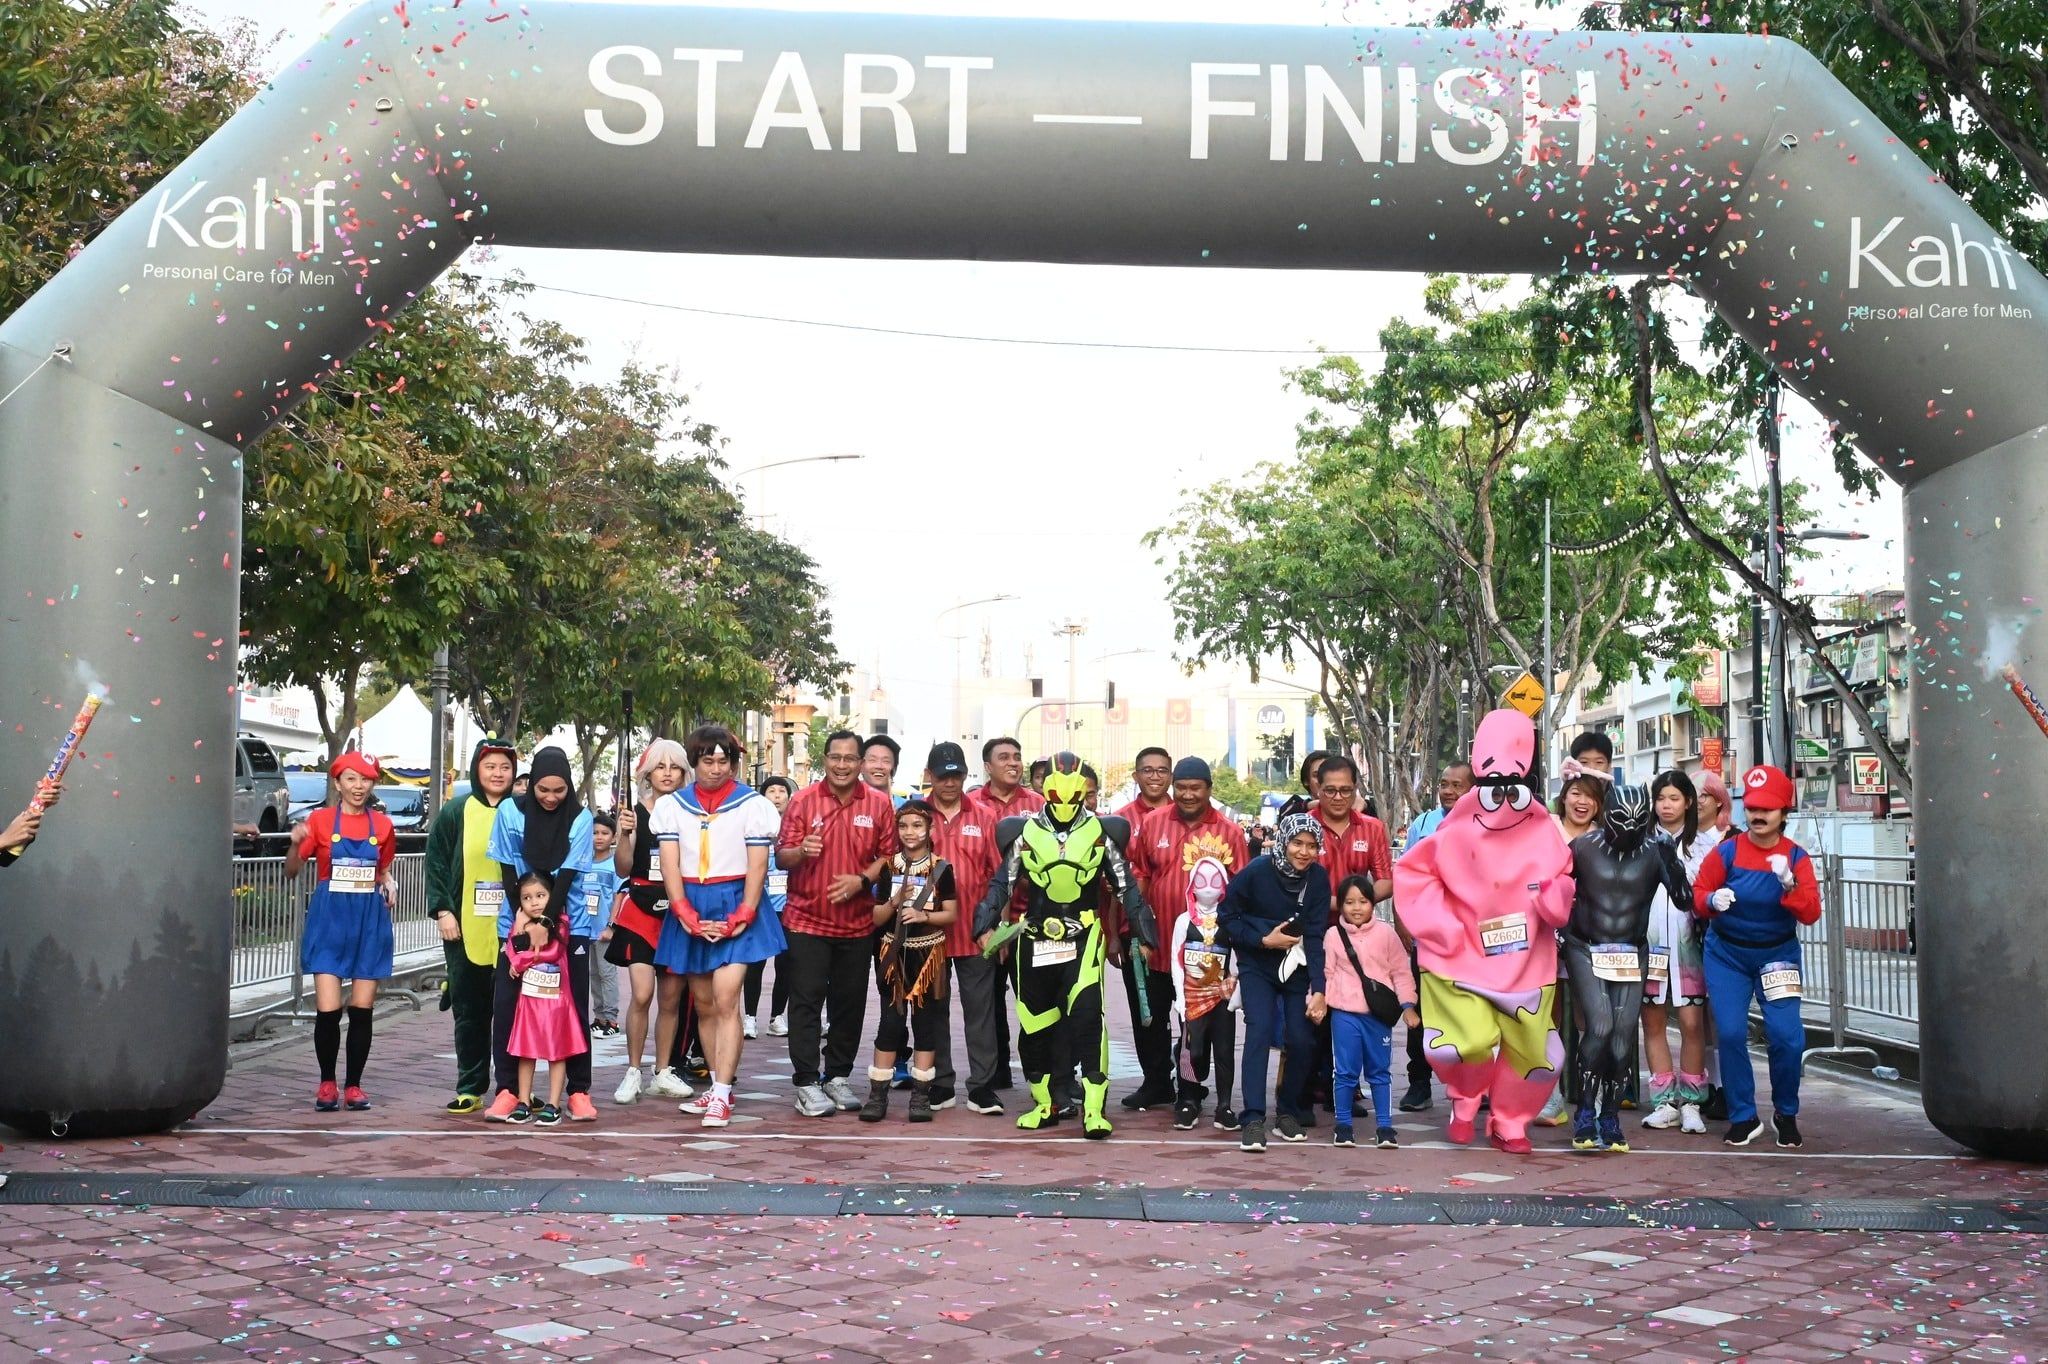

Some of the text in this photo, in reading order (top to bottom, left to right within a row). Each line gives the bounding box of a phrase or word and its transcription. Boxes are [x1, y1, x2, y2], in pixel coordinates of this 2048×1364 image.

[584, 45, 994, 154] START
[1190, 62, 1597, 167] FINISH
[147, 177, 336, 254] Kahf
[1848, 216, 2017, 291] Kahf
[143, 263, 335, 285] Personal Care for Men
[1928, 303, 1968, 319] Care
[1973, 303, 1996, 318] for
[2000, 304, 2033, 319] Men
[335, 867, 373, 879] ZC9912
[1487, 928, 1523, 945] ZC9921
[1594, 954, 1636, 966] ZC9922
[522, 969, 559, 985] ZC9934
[1763, 971, 1799, 986] ZC9920
